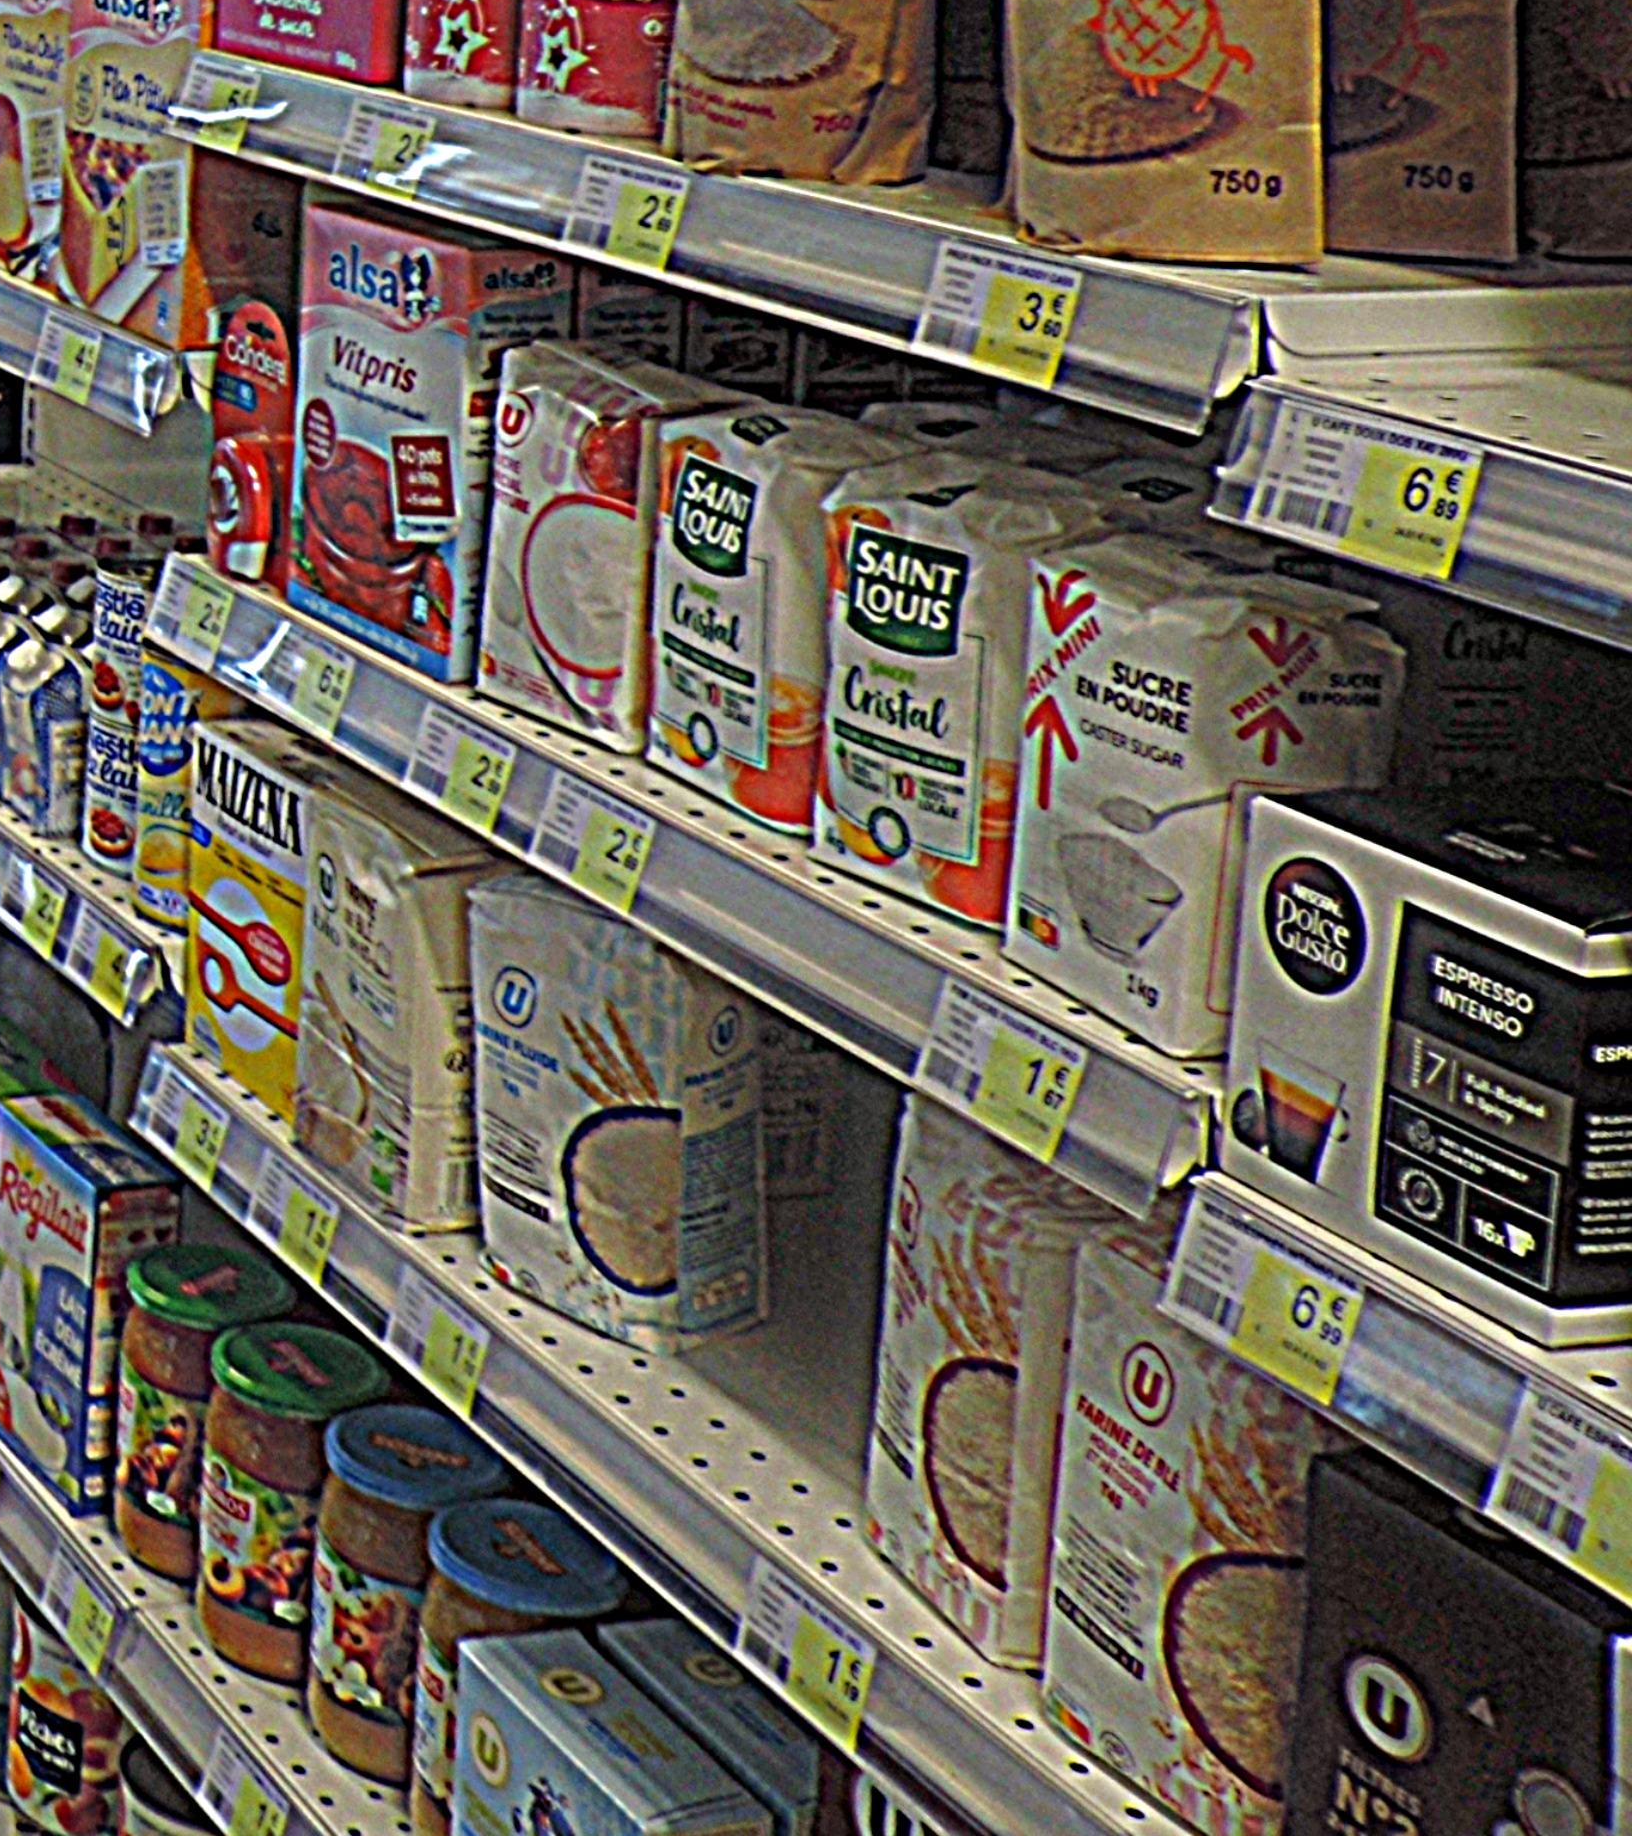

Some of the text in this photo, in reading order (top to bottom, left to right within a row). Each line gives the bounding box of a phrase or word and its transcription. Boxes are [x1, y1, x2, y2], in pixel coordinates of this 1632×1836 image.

[638, 195, 658, 229] 2
[329, 244, 400, 308] alsa
[1018, 292, 1043, 331] 3
[334, 336, 417, 394] Vitpris
[684, 468, 753, 521] SAINT
[1404, 468, 1463, 520] 6 € 89
[678, 501, 744, 554] LOUIS
[856, 541, 961, 595] SAINT
[671, 583, 742, 652] Cristal
[853, 578, 953, 631] LOUIS
[1055, 616, 1102, 673] MINI
[845, 665, 948, 739] Cristal
[1076, 677, 1187, 733] EN POUDRE
[1110, 662, 1191, 706] SUCRE
[1230, 681, 1283, 722] PRIX
[1298, 688, 1381, 709] EN POUDRE
[1329, 672, 1382, 691] SUCRE
[1080, 719, 1184, 770] CASTER SUGAR
[1276, 916, 1347, 974] Gusto
[1277, 893, 1349, 949] Dolce
[1433, 955, 1533, 1014] ESPRESSO
[1437, 985, 1522, 1038] INTENSO
[1025, 1059, 1044, 1095] 1
[1044, 1088, 1065, 1110] 67
[1427, 1051, 1446, 1084] 7
[1292, 1284, 1348, 1346] 6 € 99
[1133, 1360, 1163, 1408] U
[1077, 1395, 1132, 1450] FARINE
[827, 1650, 842, 1685] 1
[1365, 1675, 1410, 1740] U
